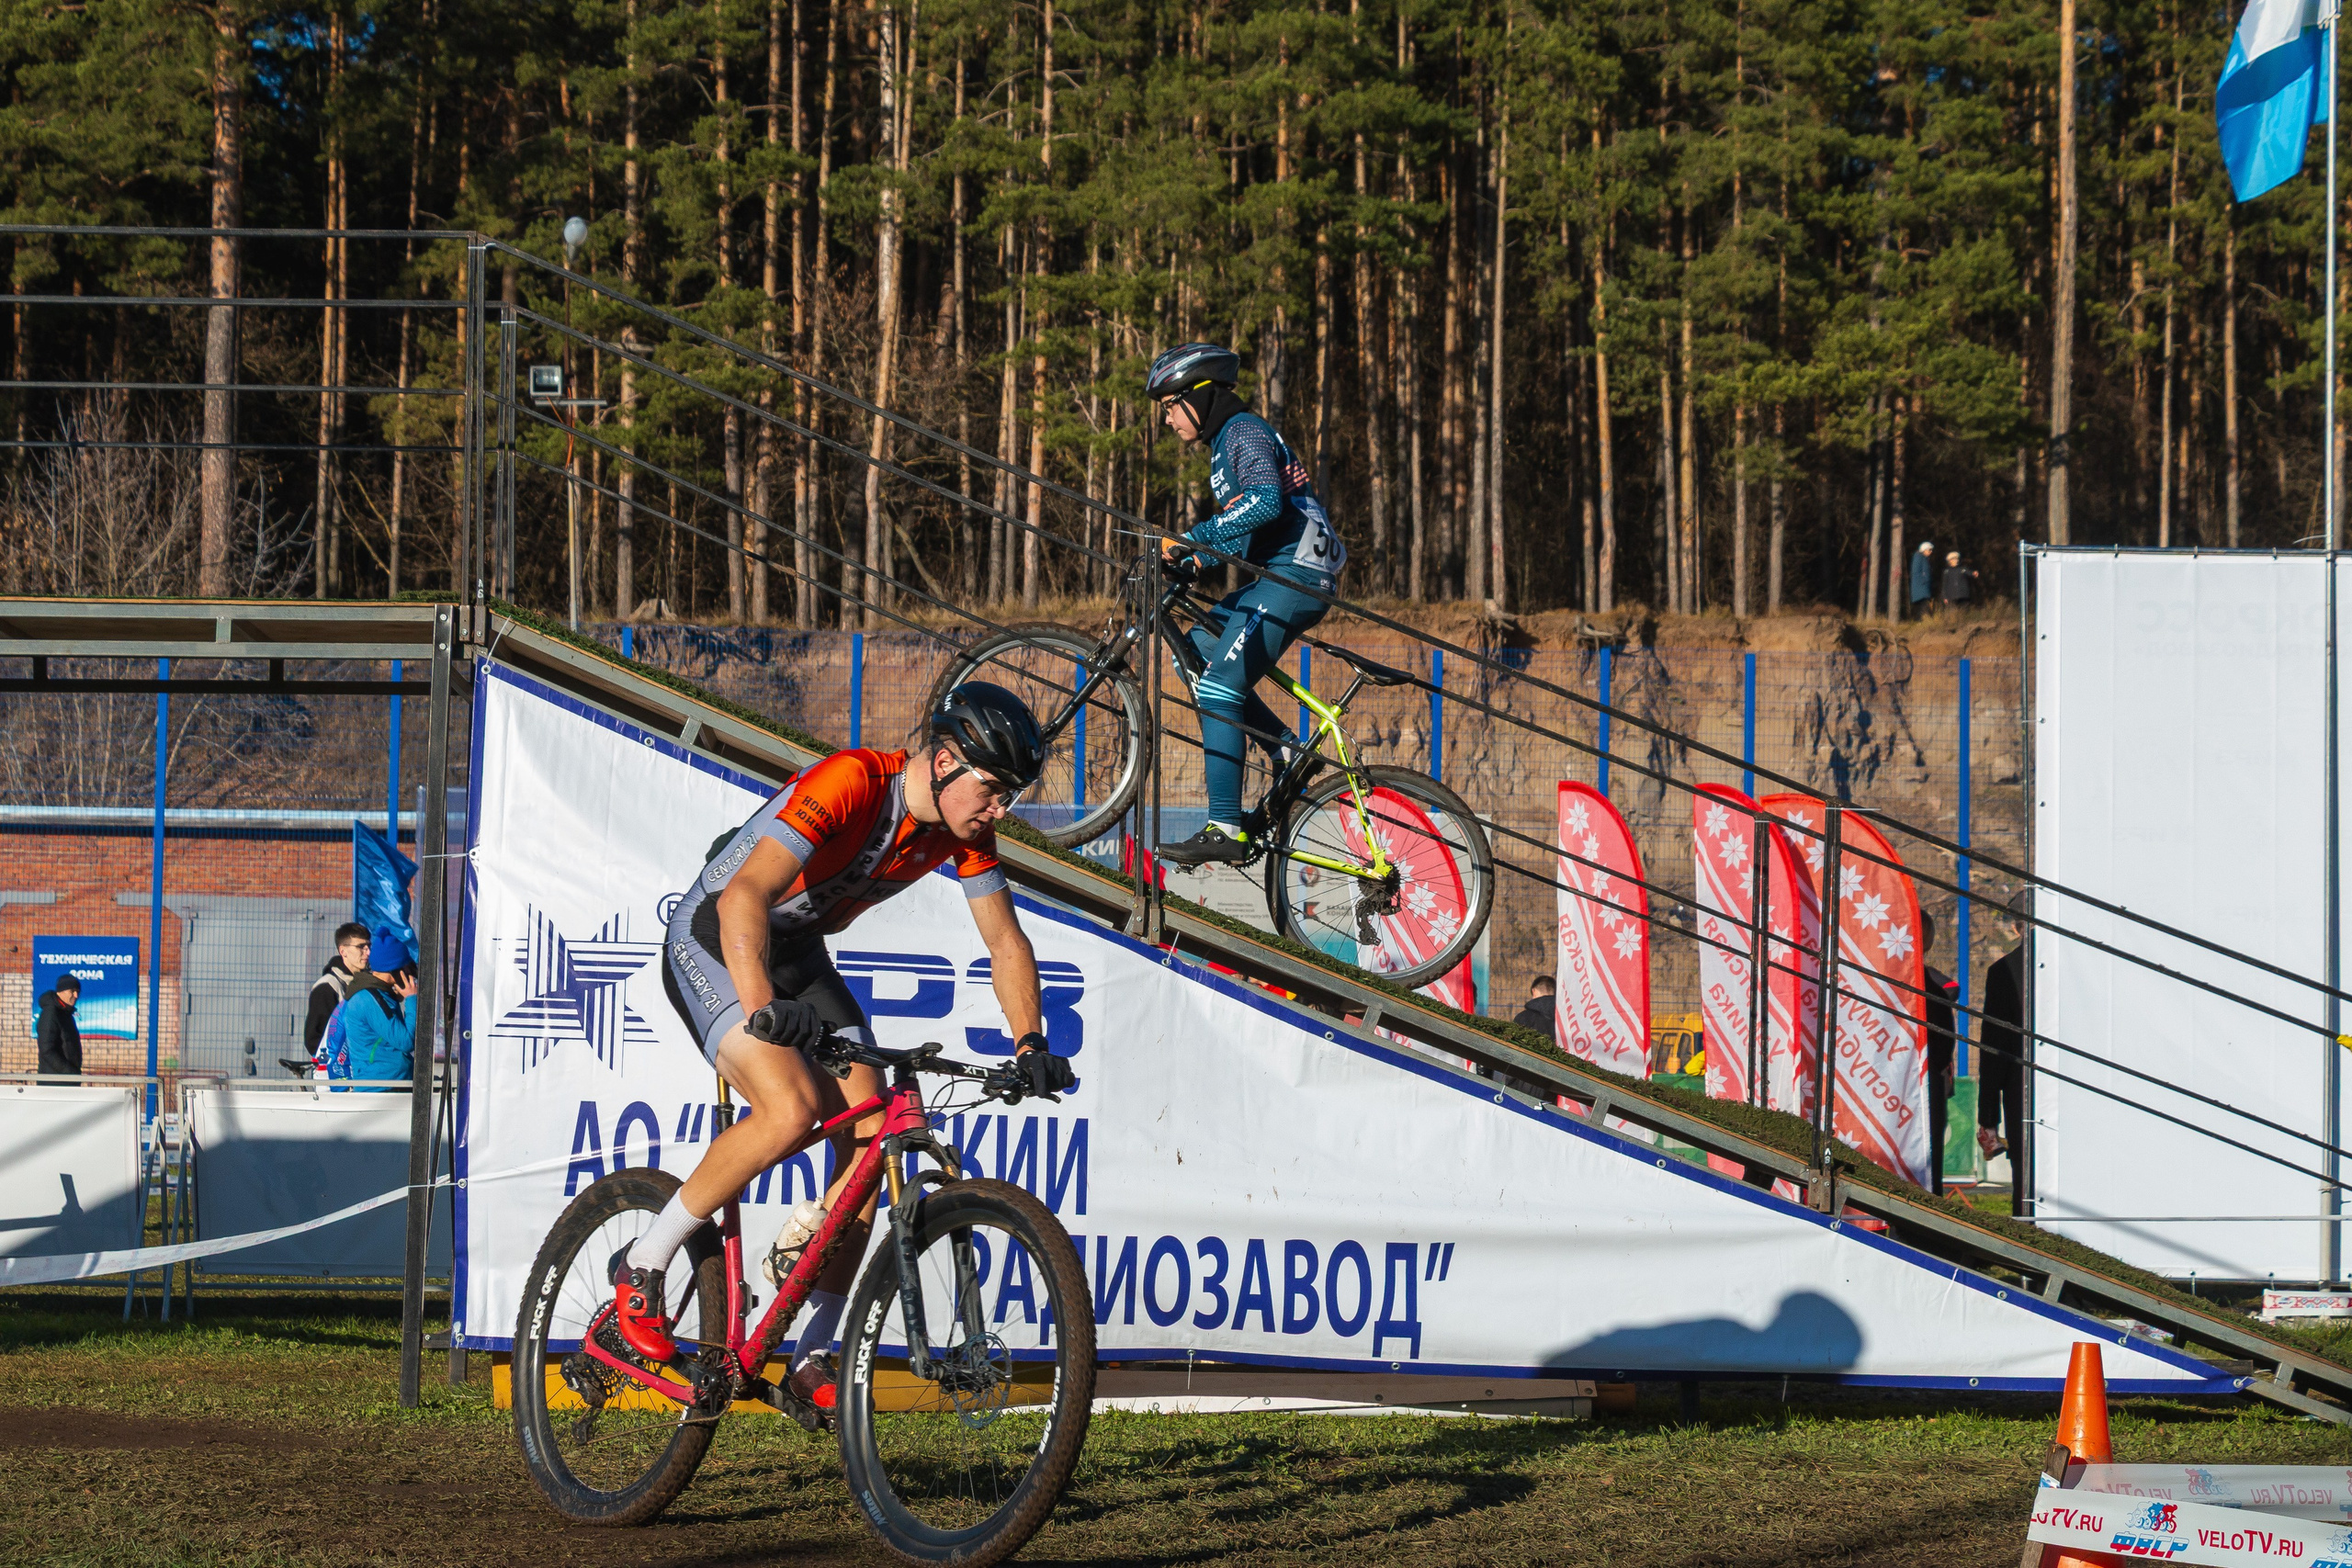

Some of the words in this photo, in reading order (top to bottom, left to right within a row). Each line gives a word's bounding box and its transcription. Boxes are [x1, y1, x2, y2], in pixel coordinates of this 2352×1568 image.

[1224, 604, 1268, 660] TREK
[707, 844, 750, 883] CENTURY
[745, 832, 759, 850] 21
[39, 953, 133, 965] ТЕХНИЧЕСКАЯ
[673, 938, 716, 999] CENTURY
[703, 995, 723, 1015] 21
[564, 1100, 662, 1197] АО
[530, 1296, 548, 1340] FUCK
[541, 1264, 558, 1296] OFF
[854, 1336, 874, 1384] FUCK
[864, 1299, 883, 1335] OFF
[2109, 1531, 2190, 1559] ФВСР
